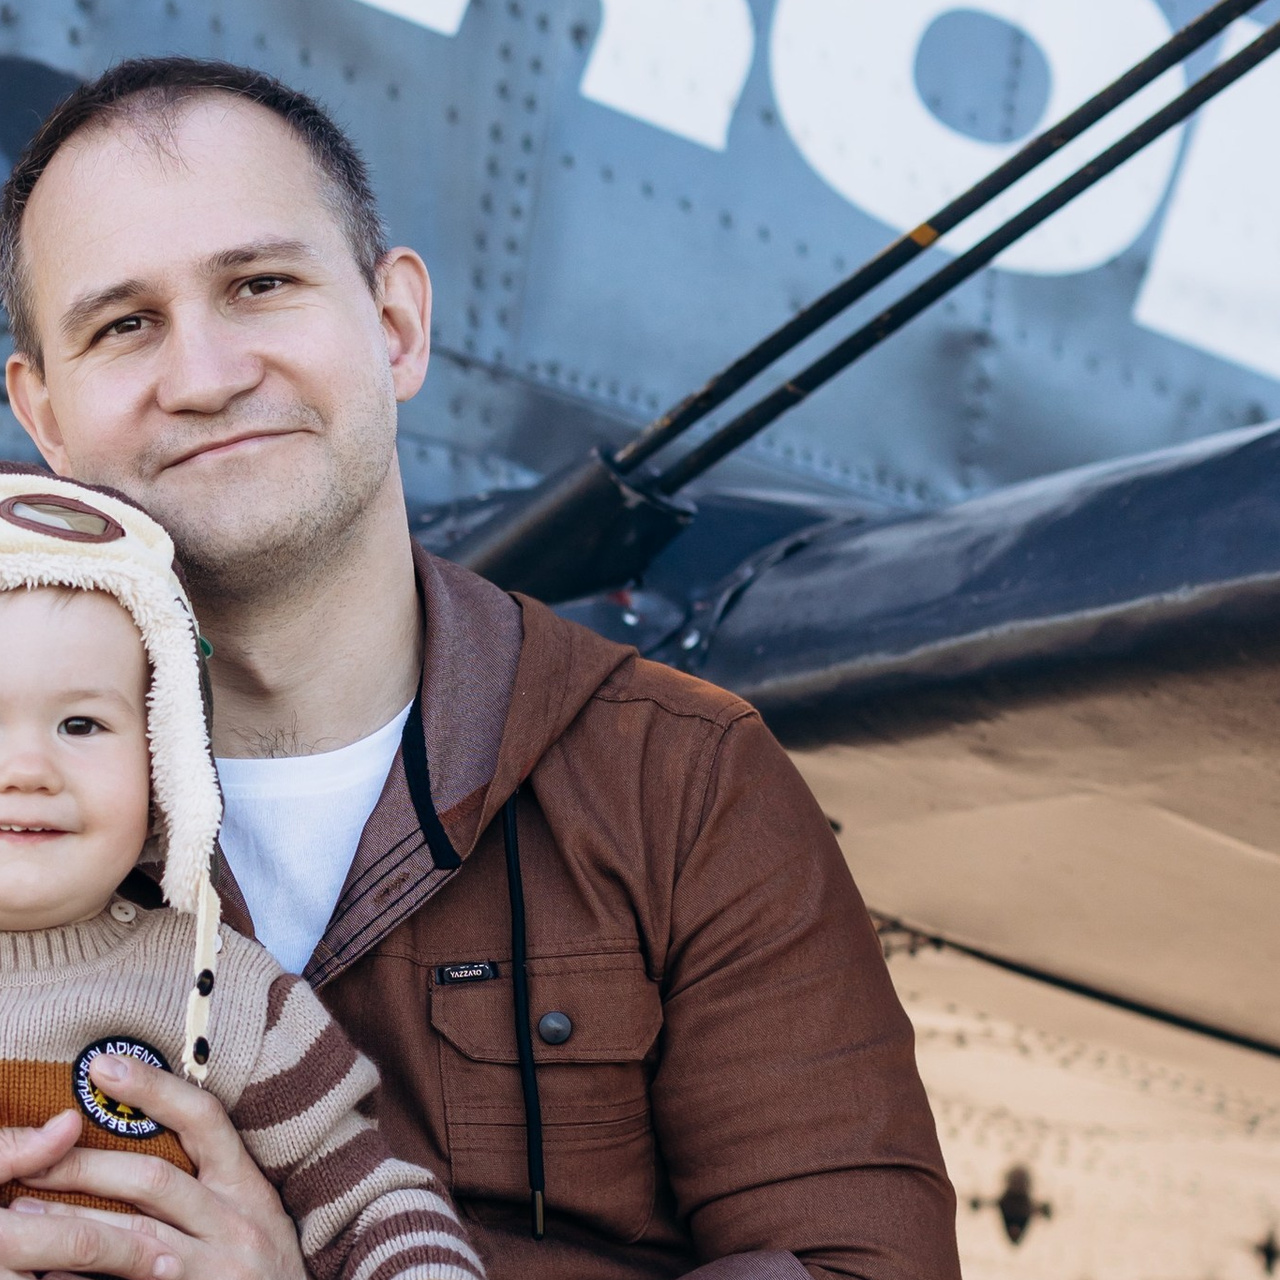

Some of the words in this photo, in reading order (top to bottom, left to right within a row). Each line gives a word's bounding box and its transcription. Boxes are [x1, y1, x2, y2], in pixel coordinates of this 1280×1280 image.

[449, 969, 483, 979] YAZZARO
[106, 1042, 163, 1068] ADVENT
[77, 1076, 127, 1132] BEAUTIFUL
